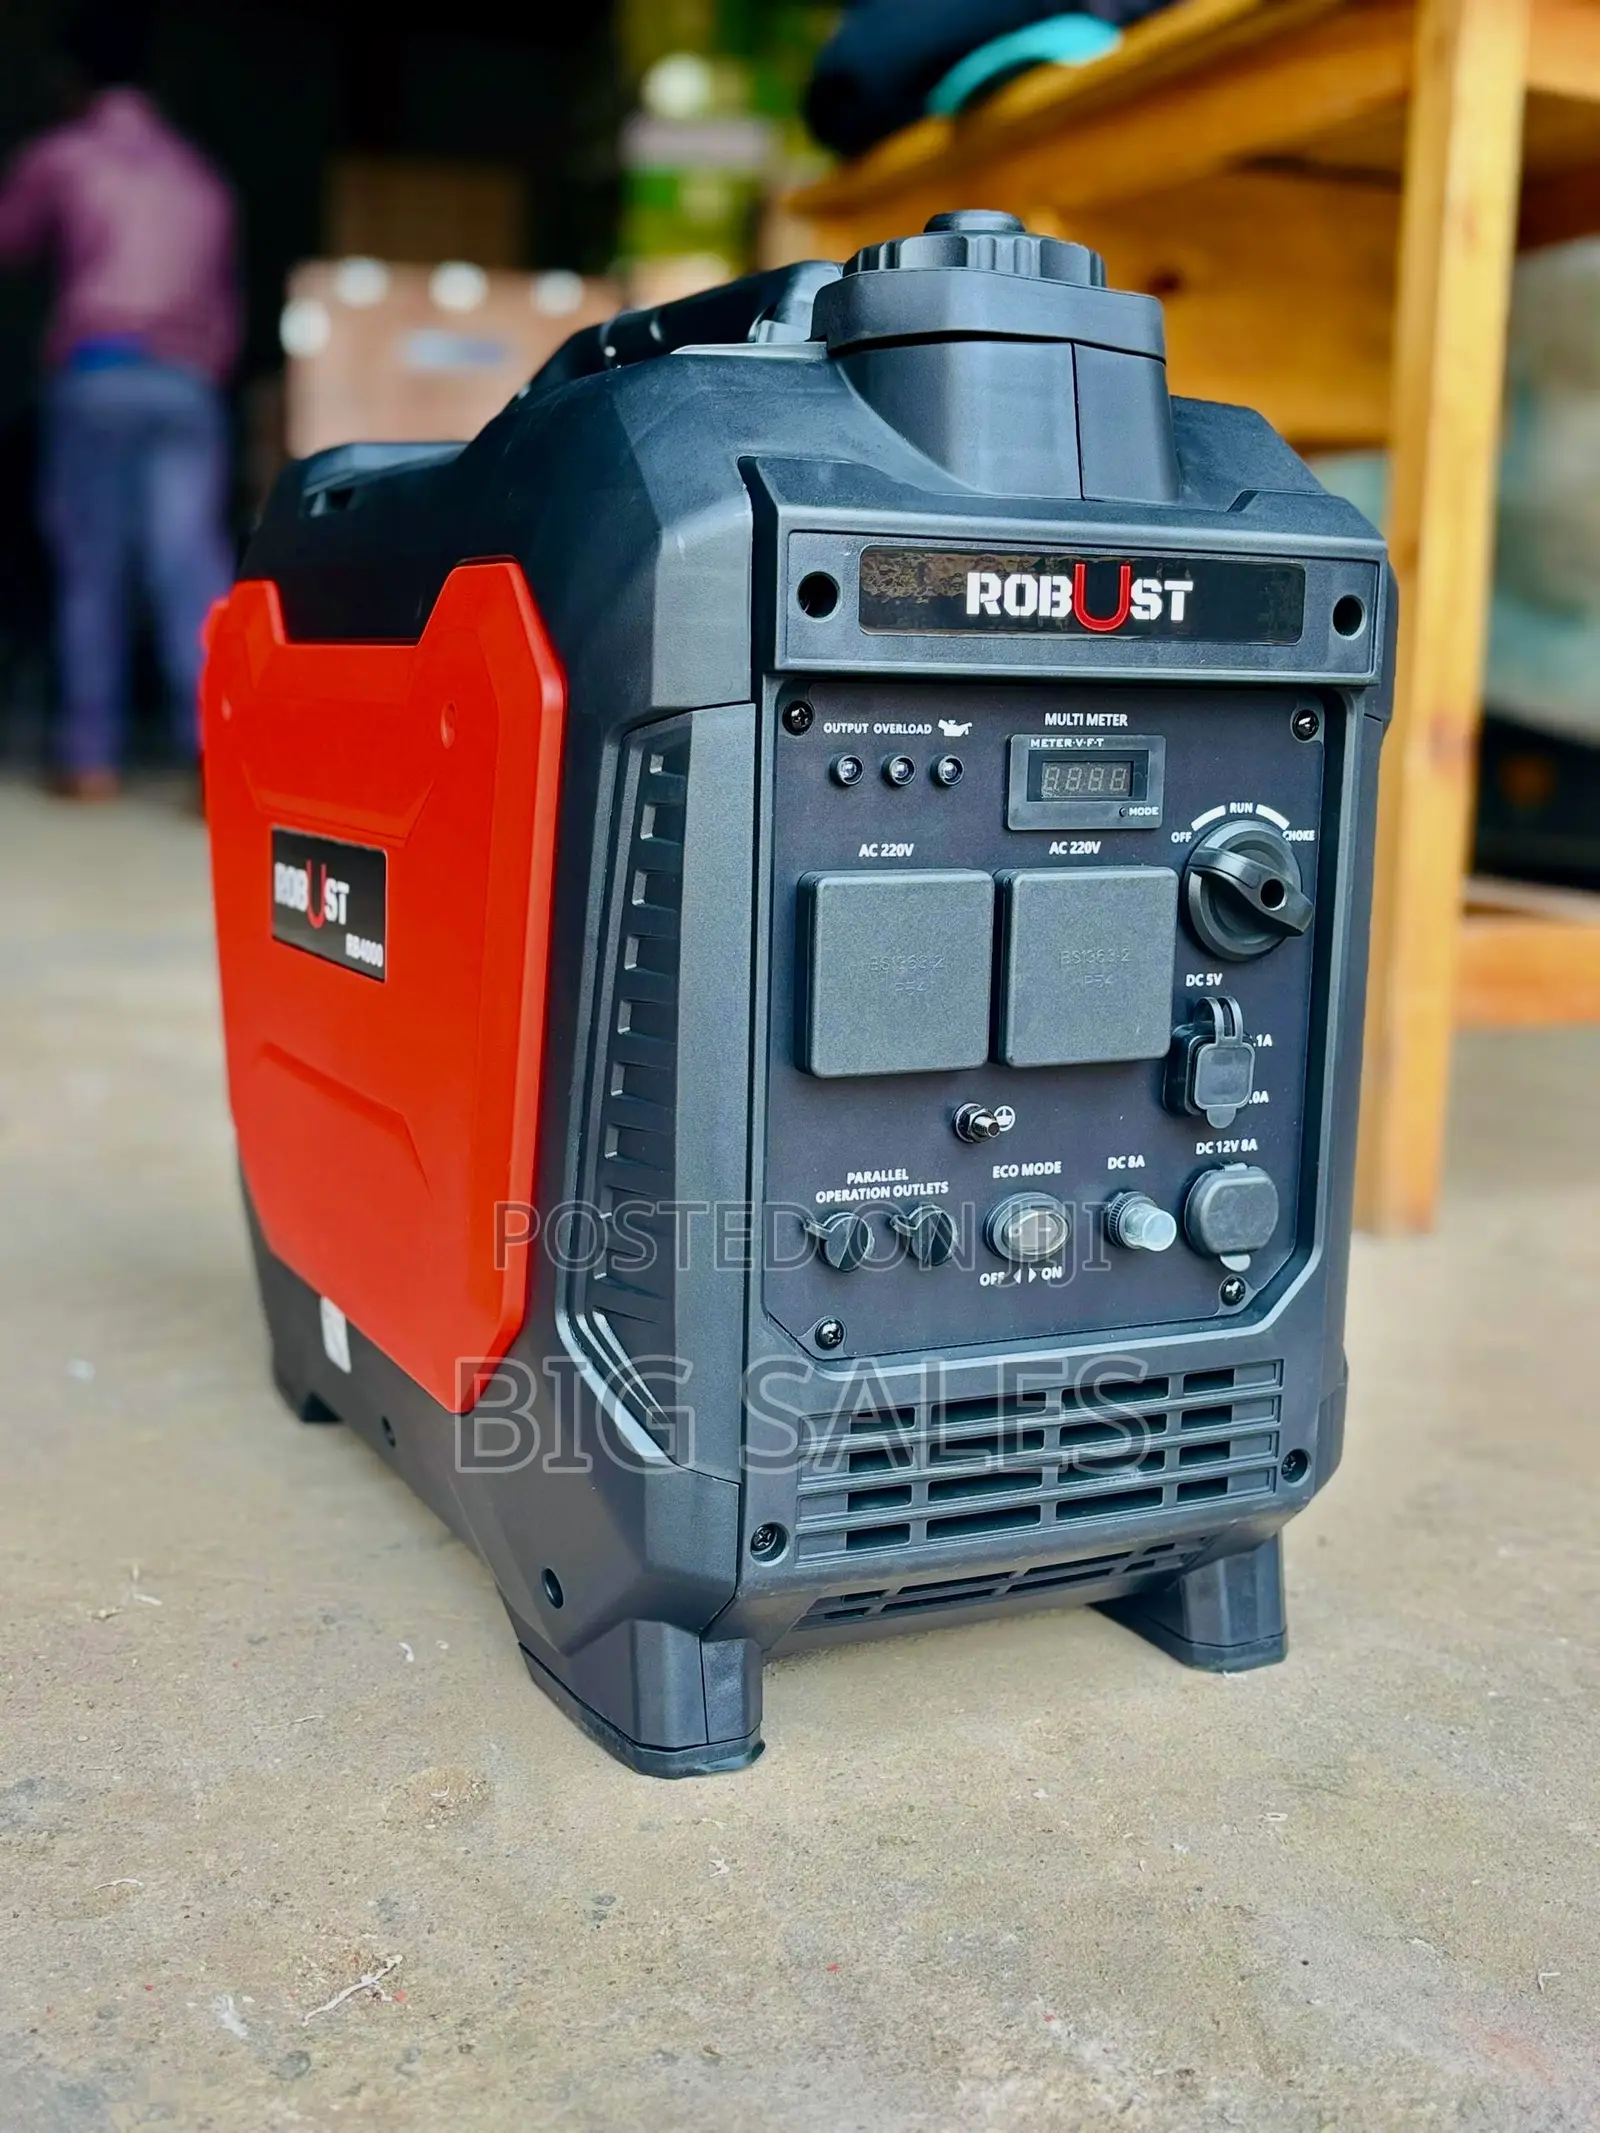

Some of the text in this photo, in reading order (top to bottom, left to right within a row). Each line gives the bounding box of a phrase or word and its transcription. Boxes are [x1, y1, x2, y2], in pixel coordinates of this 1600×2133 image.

[966, 562, 1194, 632] ROBUST
[1045, 713, 1128, 727] MULTI METER
[823, 723, 932, 735] OUTPUT OVERLOAD
[1128, 807, 1159, 816] MODE
[1229, 802, 1253, 814] RUN
[1171, 831, 1192, 843] OFF
[1282, 830, 1315, 841] CHOKE
[858, 843, 914, 857] AC 220V
[1049, 841, 1101, 855] AC 220V
[274, 859, 350, 930] ROBUST
[1186, 973, 1223, 987] DC 5V
[1196, 1138, 1258, 1155] DC 12V 8A
[1108, 1154, 1145, 1170] DC 8A
[847, 1168, 909, 1184] PARALLEL
[992, 1161, 1062, 1179] ECO MODE
[815, 1181, 949, 1203] OPERATION OUTLETS
[979, 1271, 1005, 1286] OFF
[1041, 1266, 1063, 1280] ON
